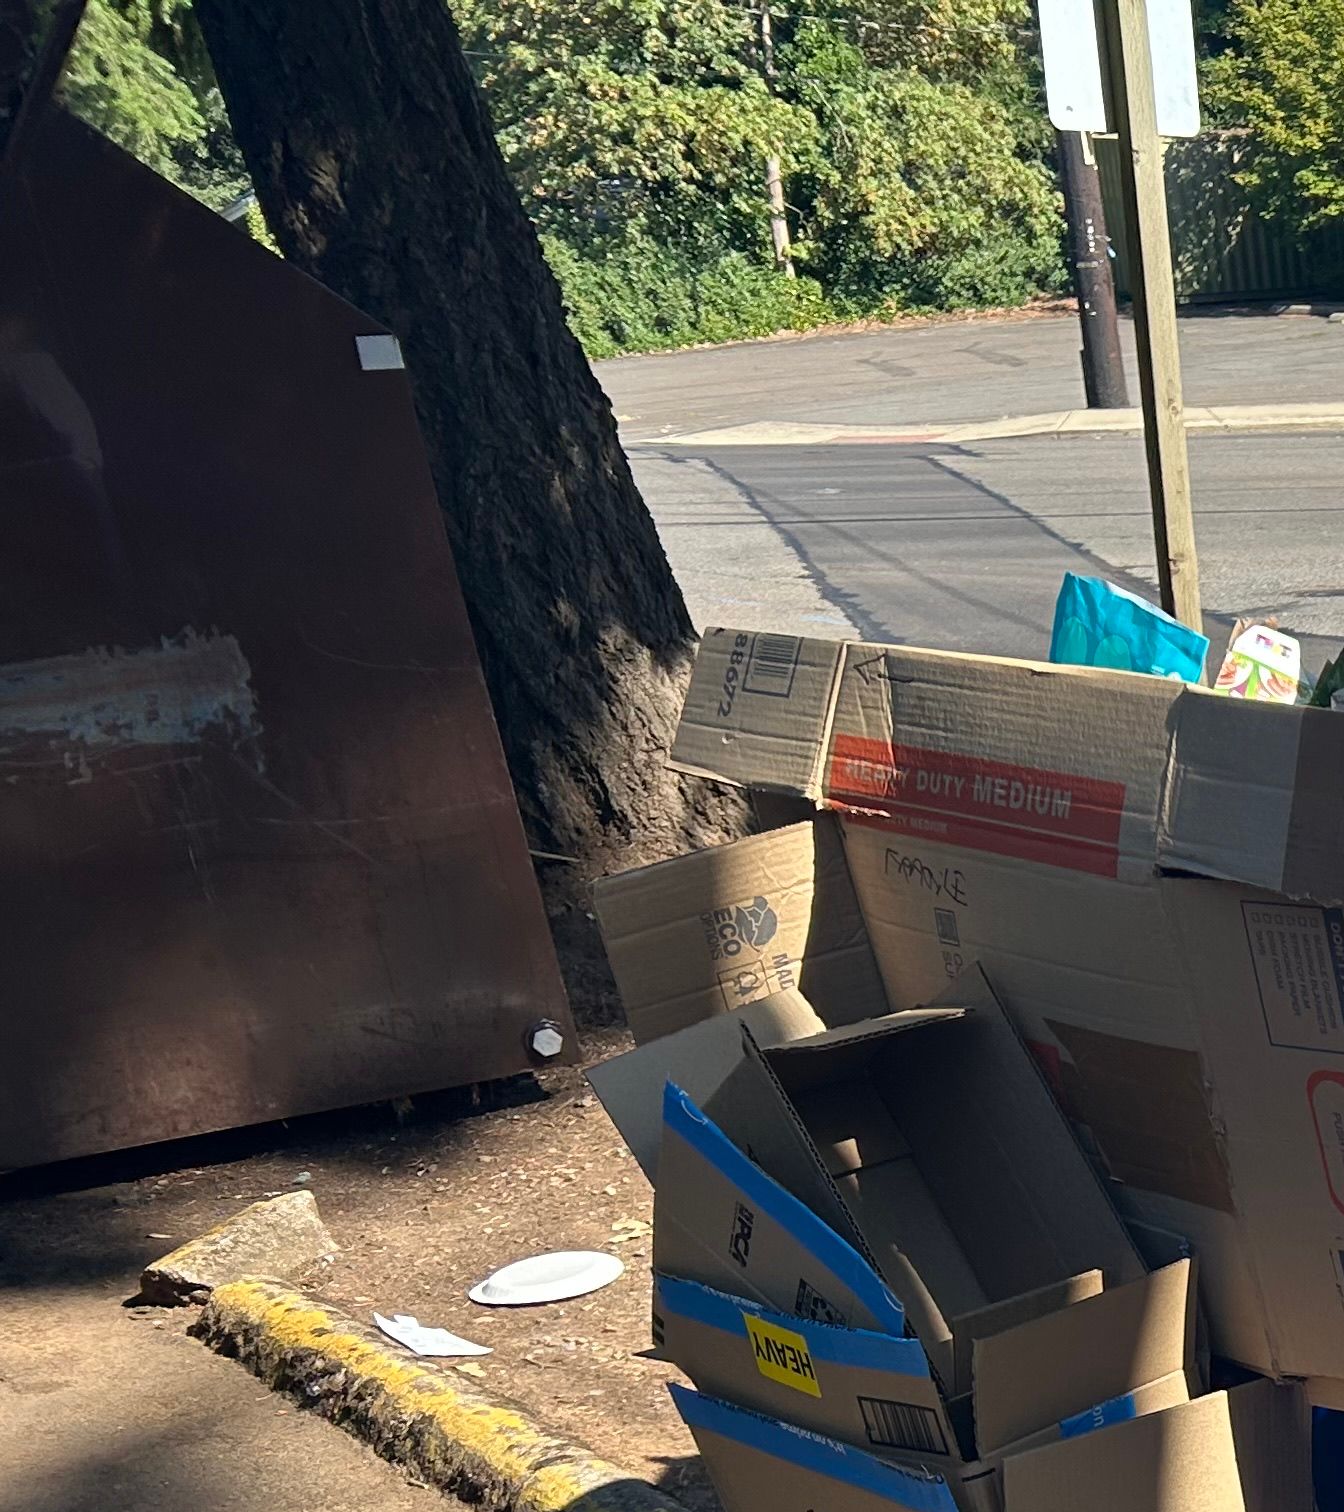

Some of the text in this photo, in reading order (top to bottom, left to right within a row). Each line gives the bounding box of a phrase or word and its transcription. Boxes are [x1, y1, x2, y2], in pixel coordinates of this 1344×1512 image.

[916, 769, 969, 799] DUTY
[973, 775, 1073, 820] MEDIUM
[700, 910, 721, 960] OPTIONS
[713, 907, 742, 957] ECO
[752, 1331, 816, 1381] HEAVY
